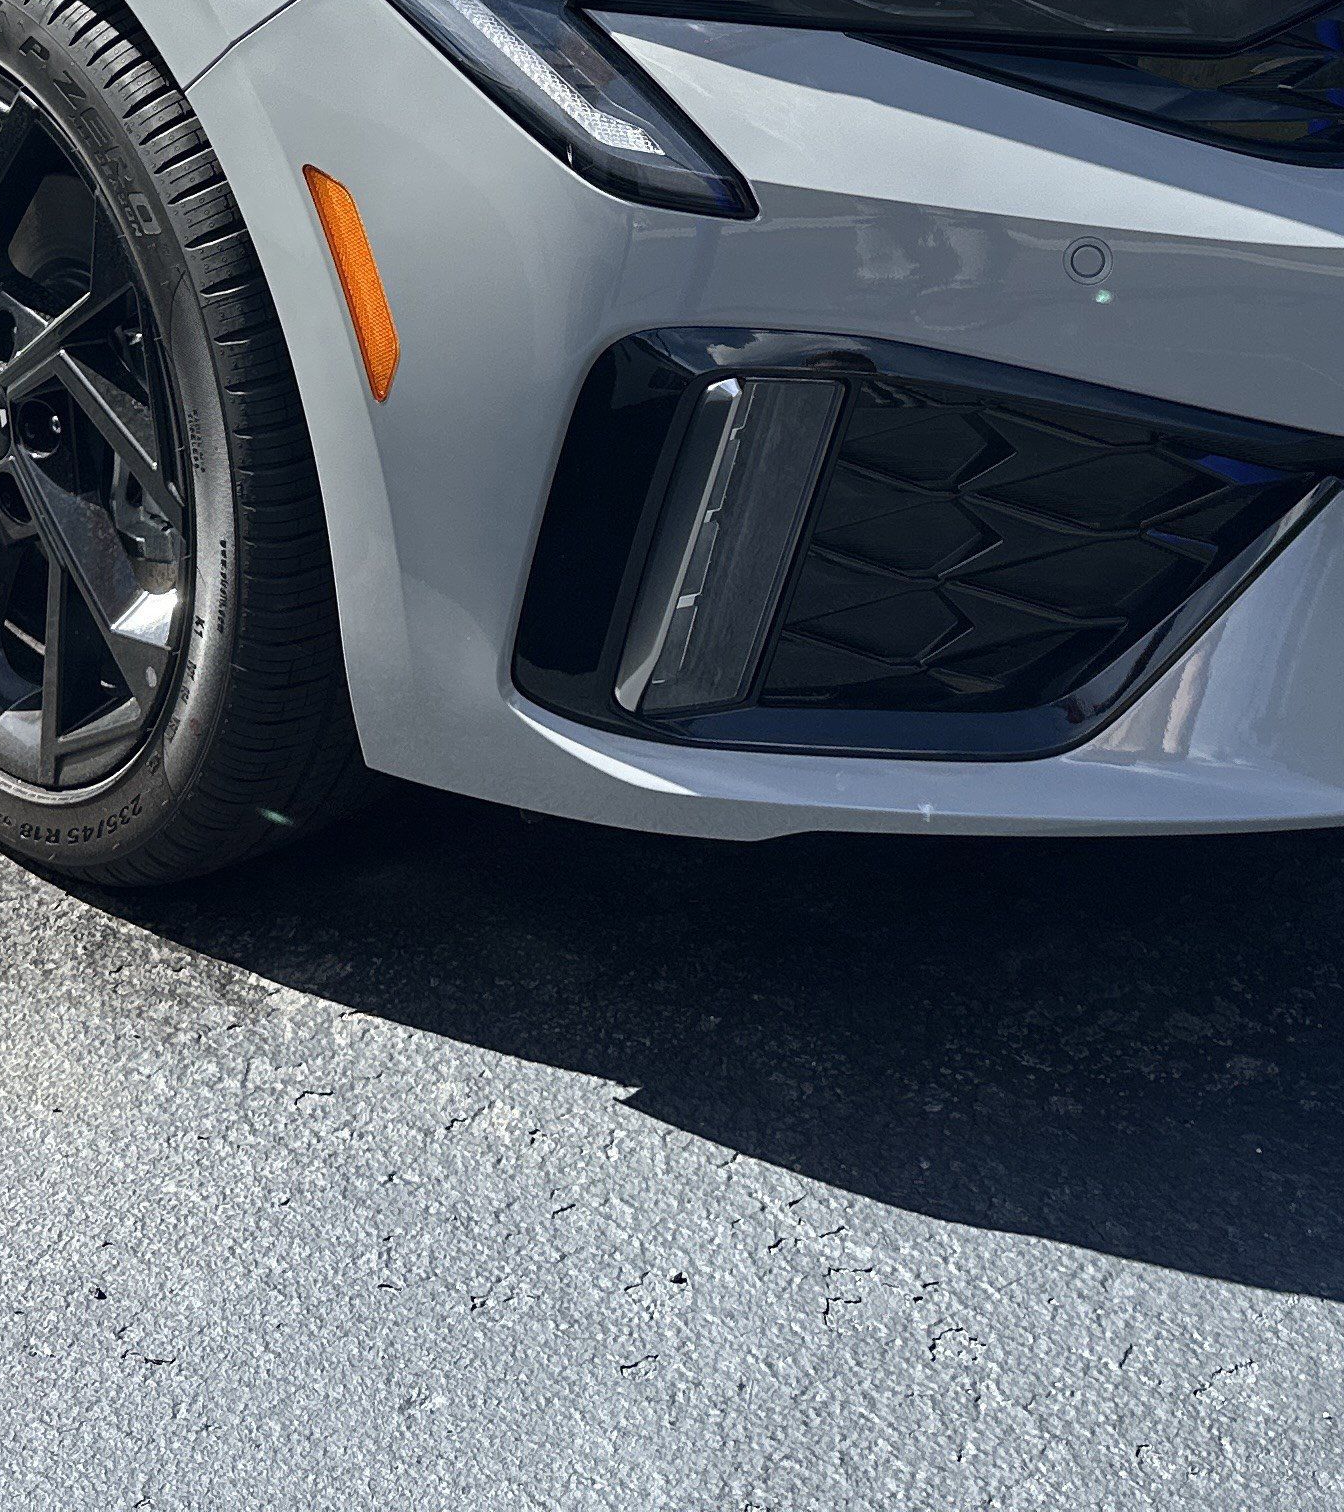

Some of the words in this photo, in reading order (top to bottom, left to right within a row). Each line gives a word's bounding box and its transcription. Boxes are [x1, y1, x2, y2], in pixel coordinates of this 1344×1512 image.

[18, 35, 51, 63] P
[53, 69, 162, 236] ZERO
[19, 821, 61, 846] R18
[67, 793, 144, 845] 235/45
